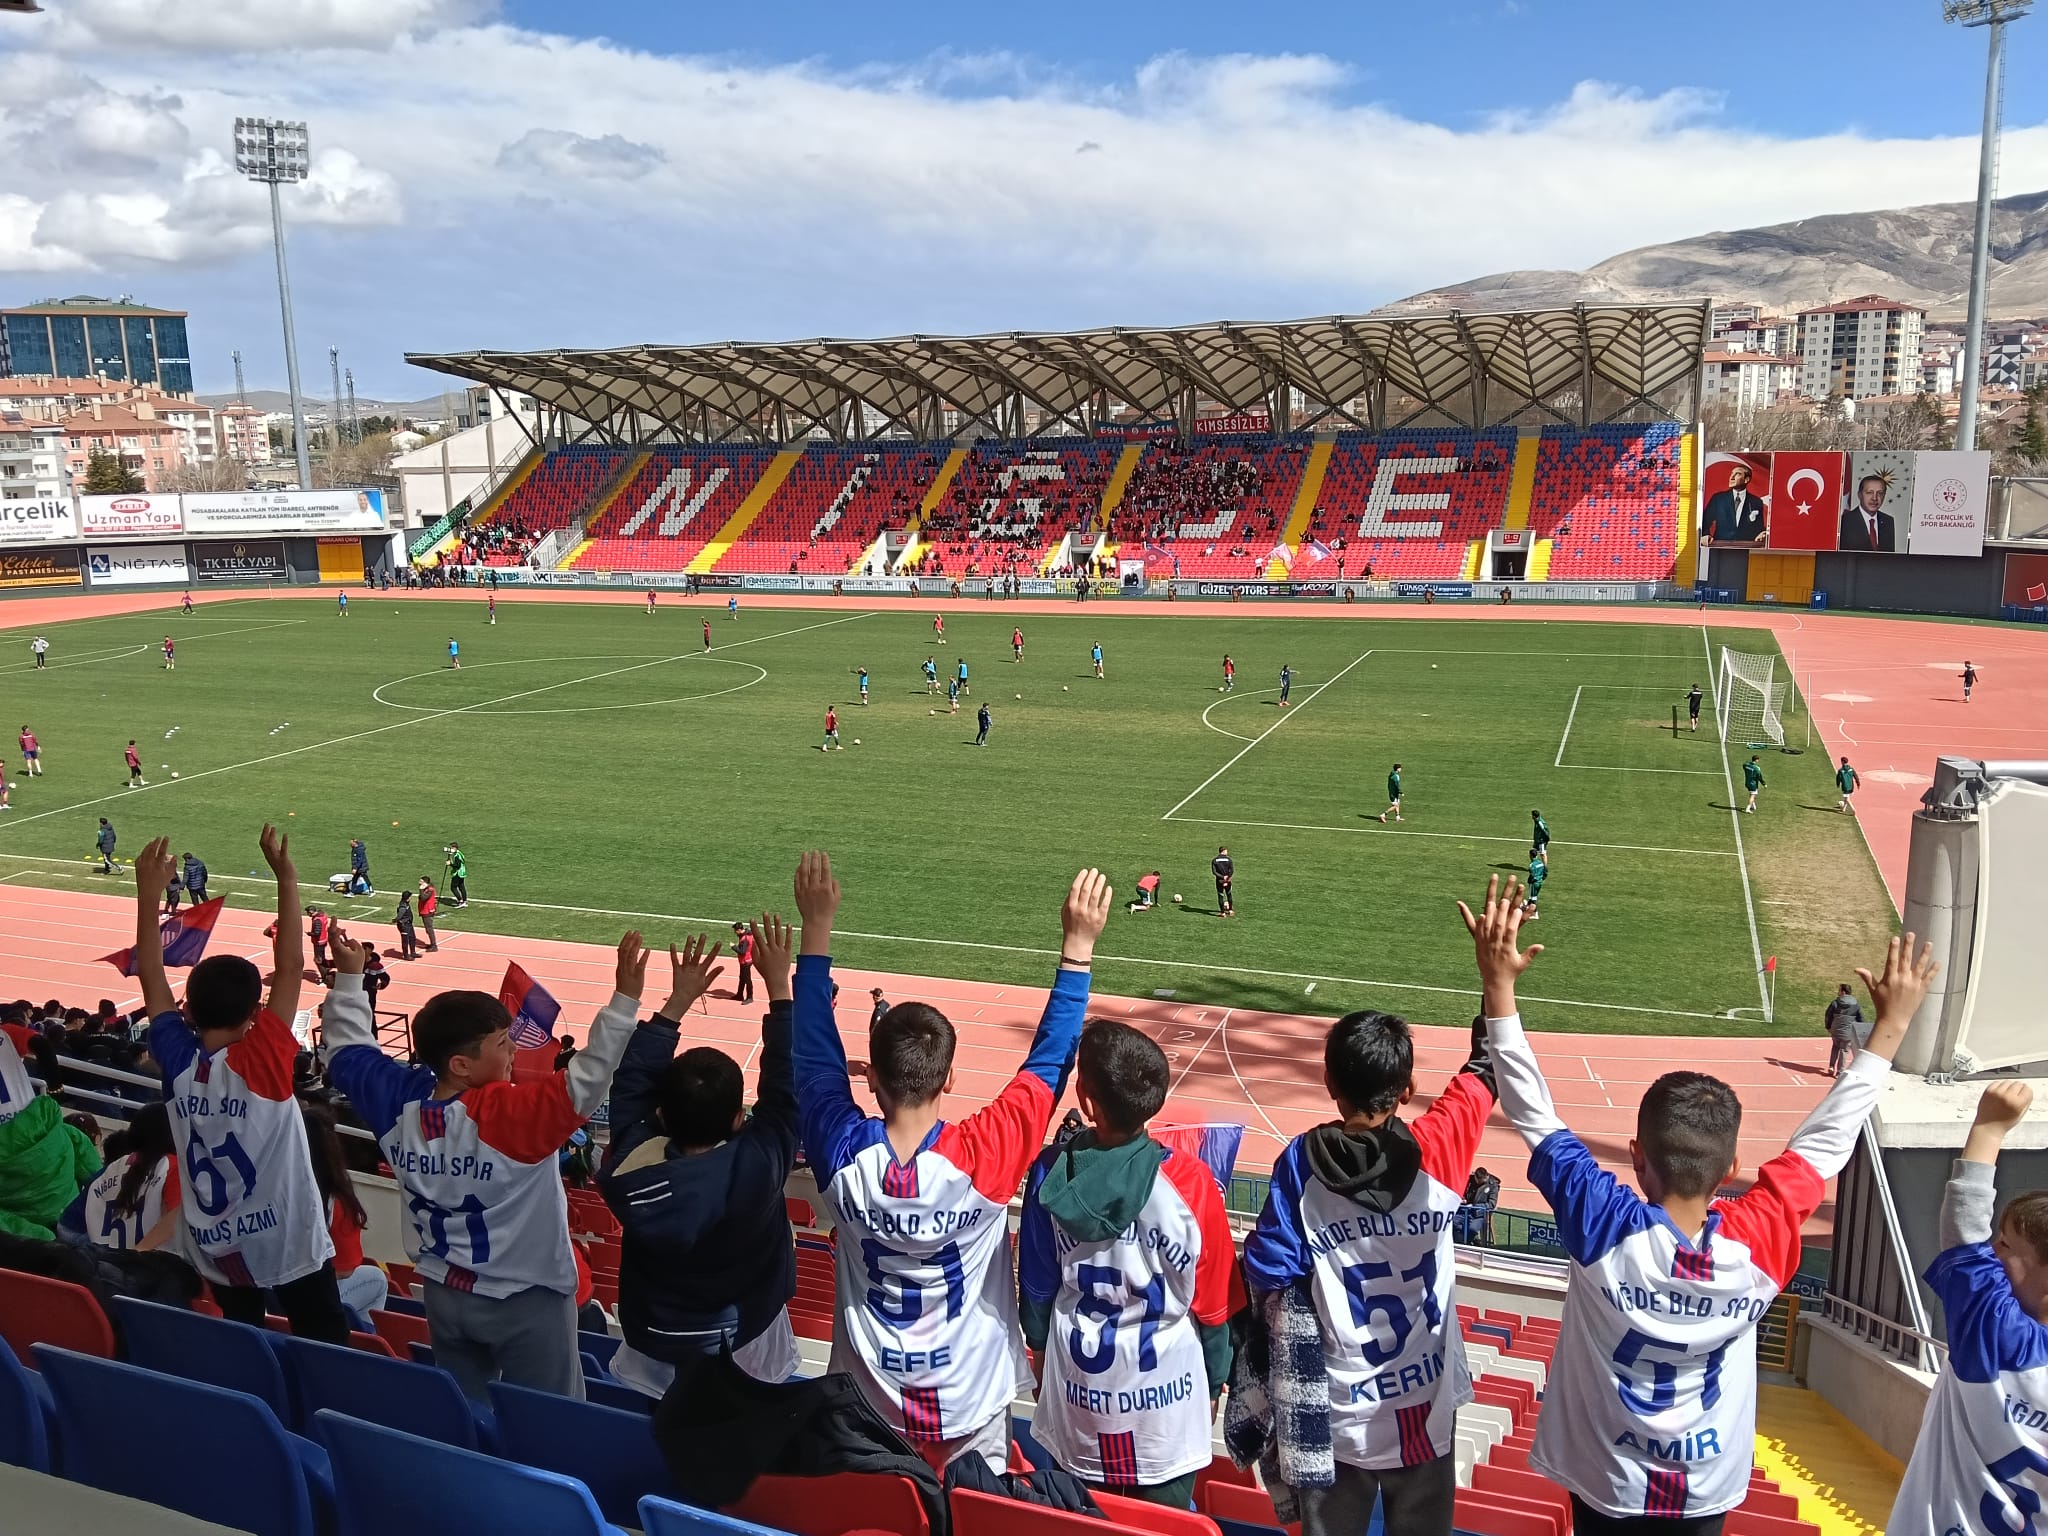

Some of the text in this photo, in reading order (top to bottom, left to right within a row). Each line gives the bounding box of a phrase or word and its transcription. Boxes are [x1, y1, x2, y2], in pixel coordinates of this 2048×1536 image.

[1196, 415, 1270, 433] KİMSESİZLER
[0, 501, 69, 523] rçelik
[87, 512, 177, 524] Uzman Yapı
[1936, 513, 1964, 521] GENÇLİK
[203, 556, 276, 569] TK TEK YAPI
[1200, 583, 1230, 595] GÜZEL
[1172, 1030, 1196, 1042] 2
[236, 1203, 278, 1237] AZMİ
[882, 1212, 926, 1236] BLD.
[932, 1208, 983, 1235] SPOR
[1357, 1214, 1402, 1238] BLD.
[1146, 1227, 1192, 1274] SPOR
[861, 1238, 966, 1331] 51
[1342, 1249, 1442, 1368] 51
[1669, 1290, 1715, 1318] BLD.
[1069, 1263, 1166, 1375] 51
[881, 1345, 952, 1373] EFE
[1613, 1327, 1738, 1417] 51
[1066, 1371, 1193, 1415] MERT DURMUŞ
[1613, 1427, 1722, 1462] AMİR
